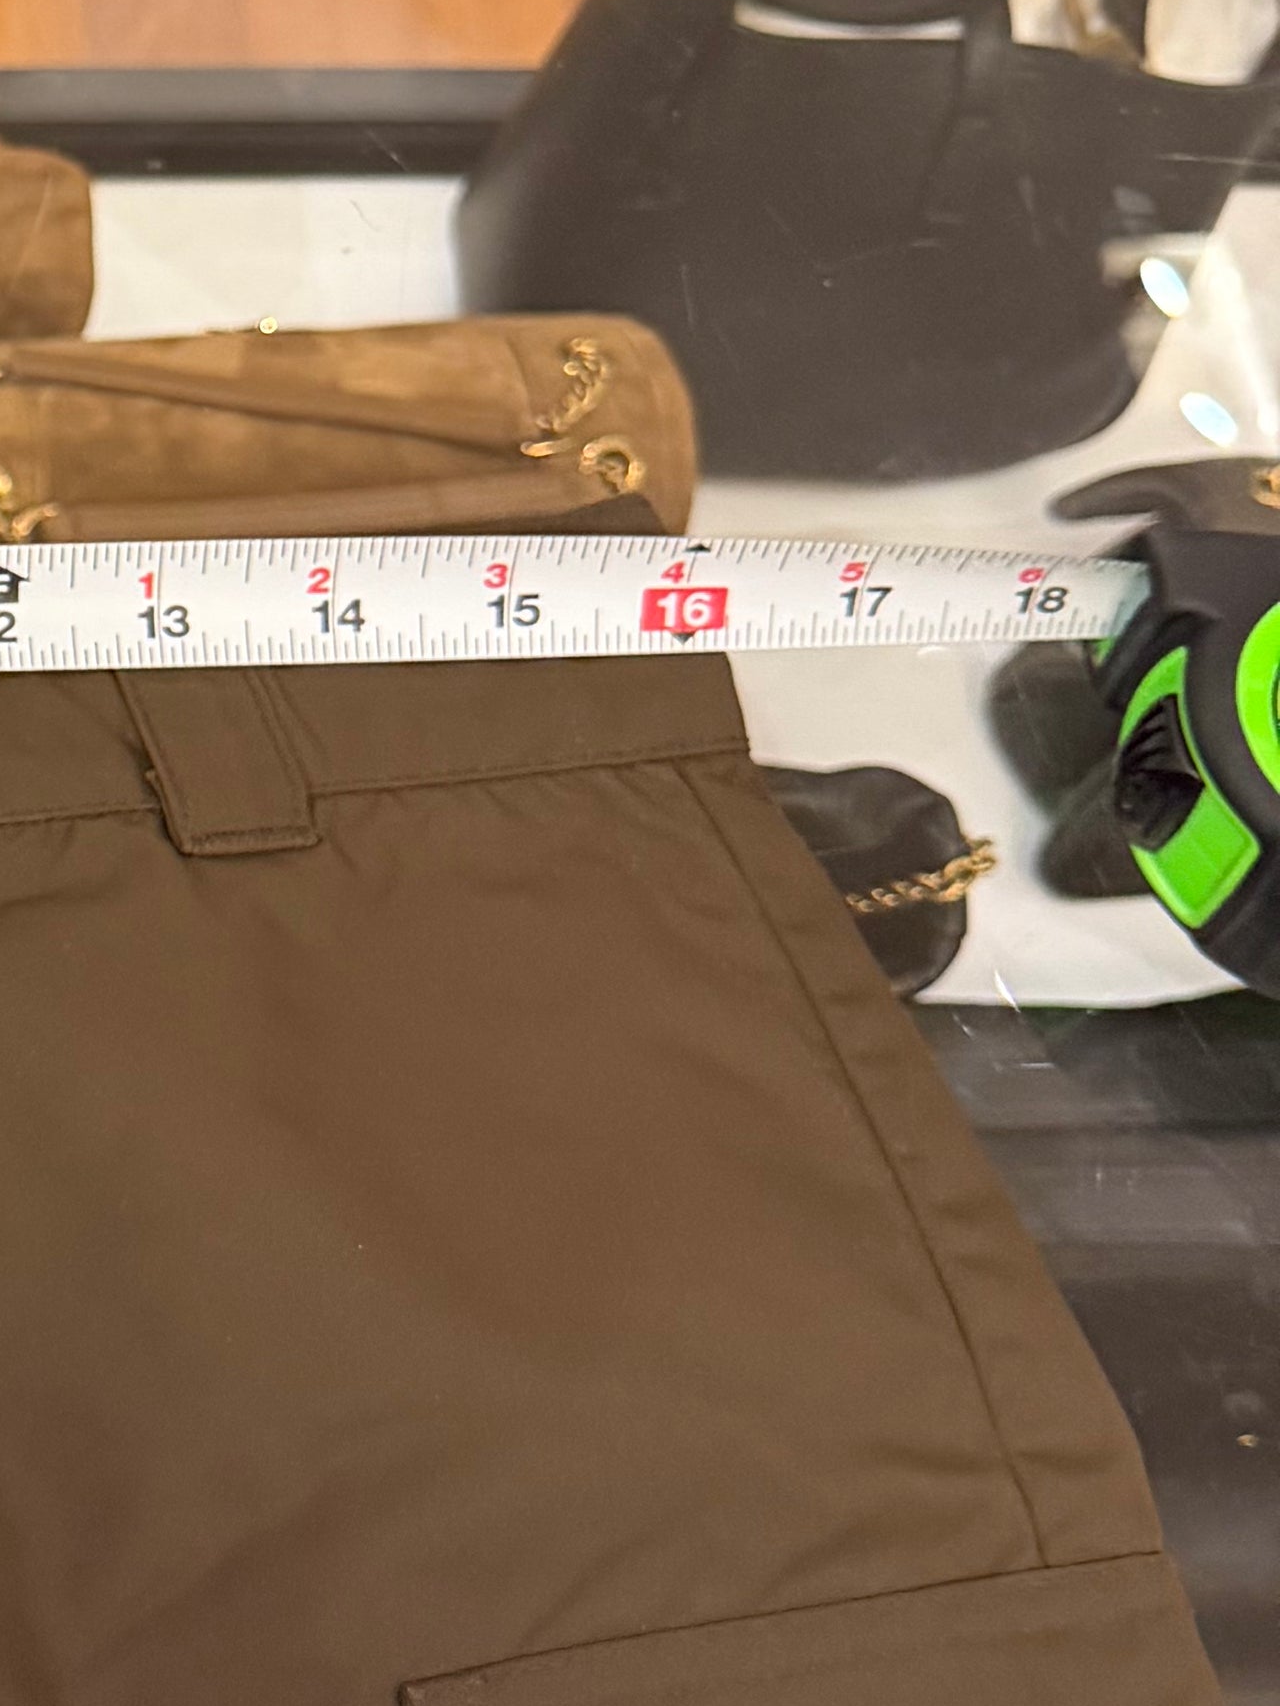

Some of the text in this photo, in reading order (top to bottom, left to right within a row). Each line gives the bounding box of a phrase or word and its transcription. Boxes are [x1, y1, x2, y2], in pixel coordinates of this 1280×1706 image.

[138, 571, 155, 599] 1
[307, 567, 332, 594] 2
[484, 563, 510, 589] 3
[660, 561, 686, 584] 4
[839, 561, 867, 583] 5
[1017, 567, 1045, 584] 6
[486, 593, 541, 629] 15
[655, 591, 712, 628] 16
[838, 586, 893, 619] 17
[1013, 586, 1069, 615] 18
[138, 604, 191, 639] 13
[311, 598, 366, 634] 14
